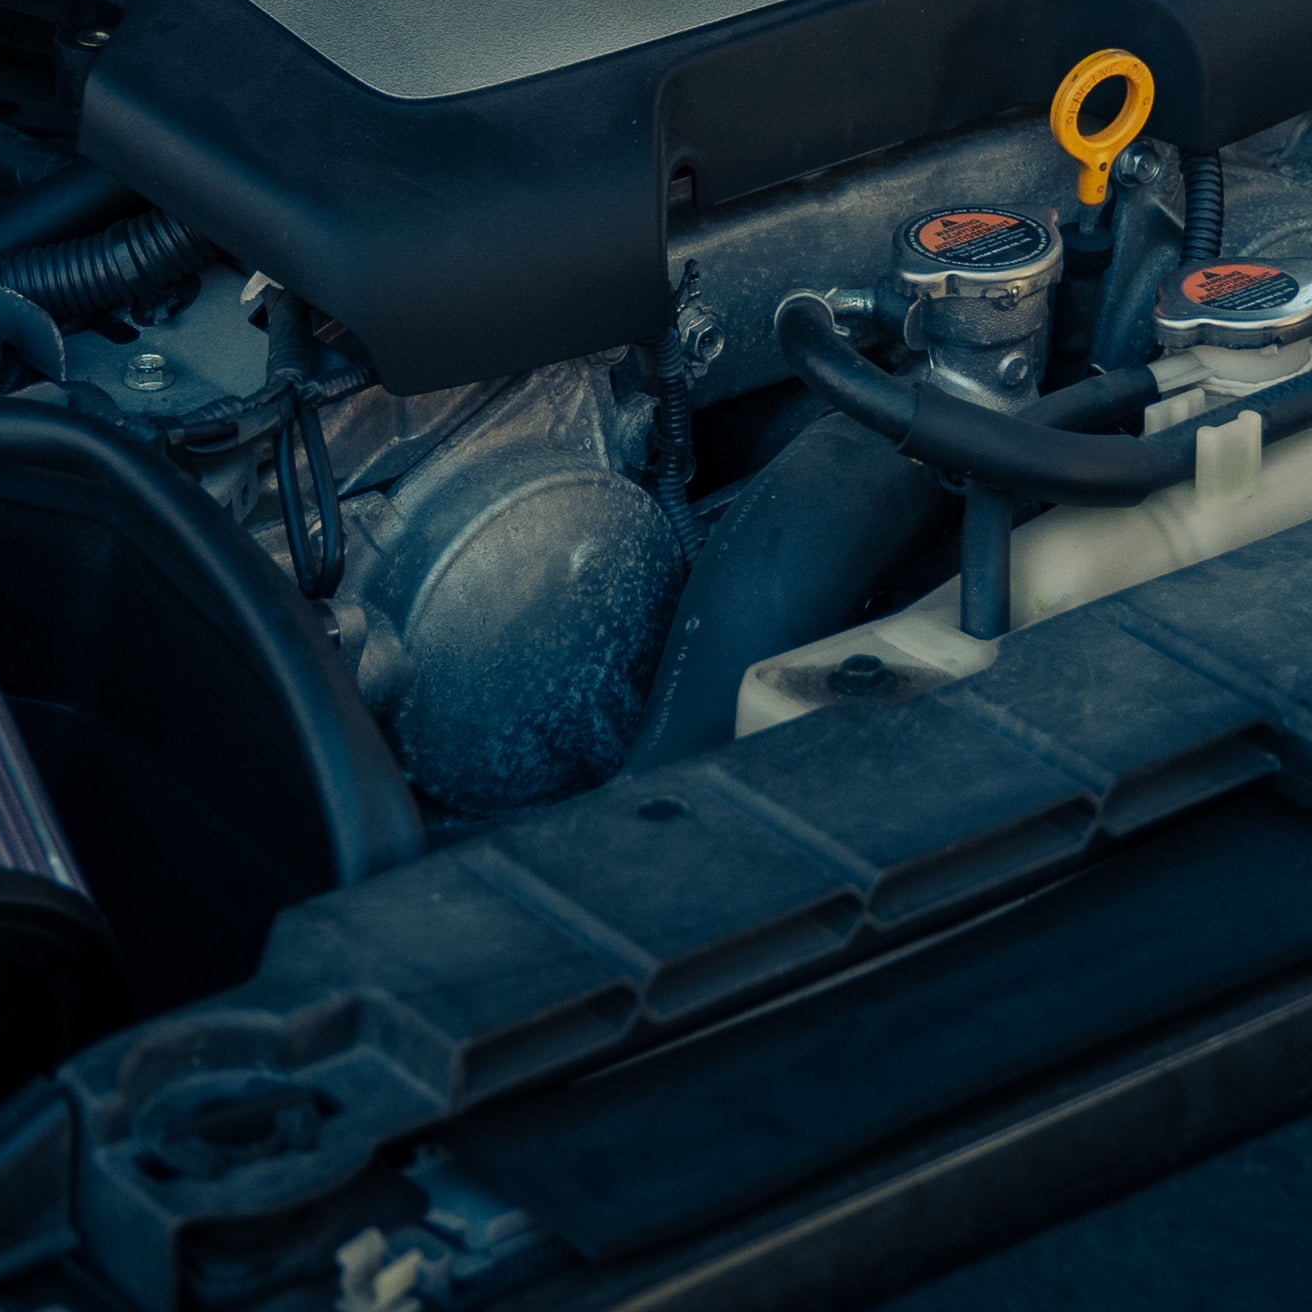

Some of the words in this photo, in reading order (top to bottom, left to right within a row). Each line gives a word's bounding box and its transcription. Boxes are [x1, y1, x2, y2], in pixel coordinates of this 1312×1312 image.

[935, 219, 980, 237] WARNING
[941, 222, 990, 242] ACHTUNG
[1197, 271, 1243, 288] WARNING
